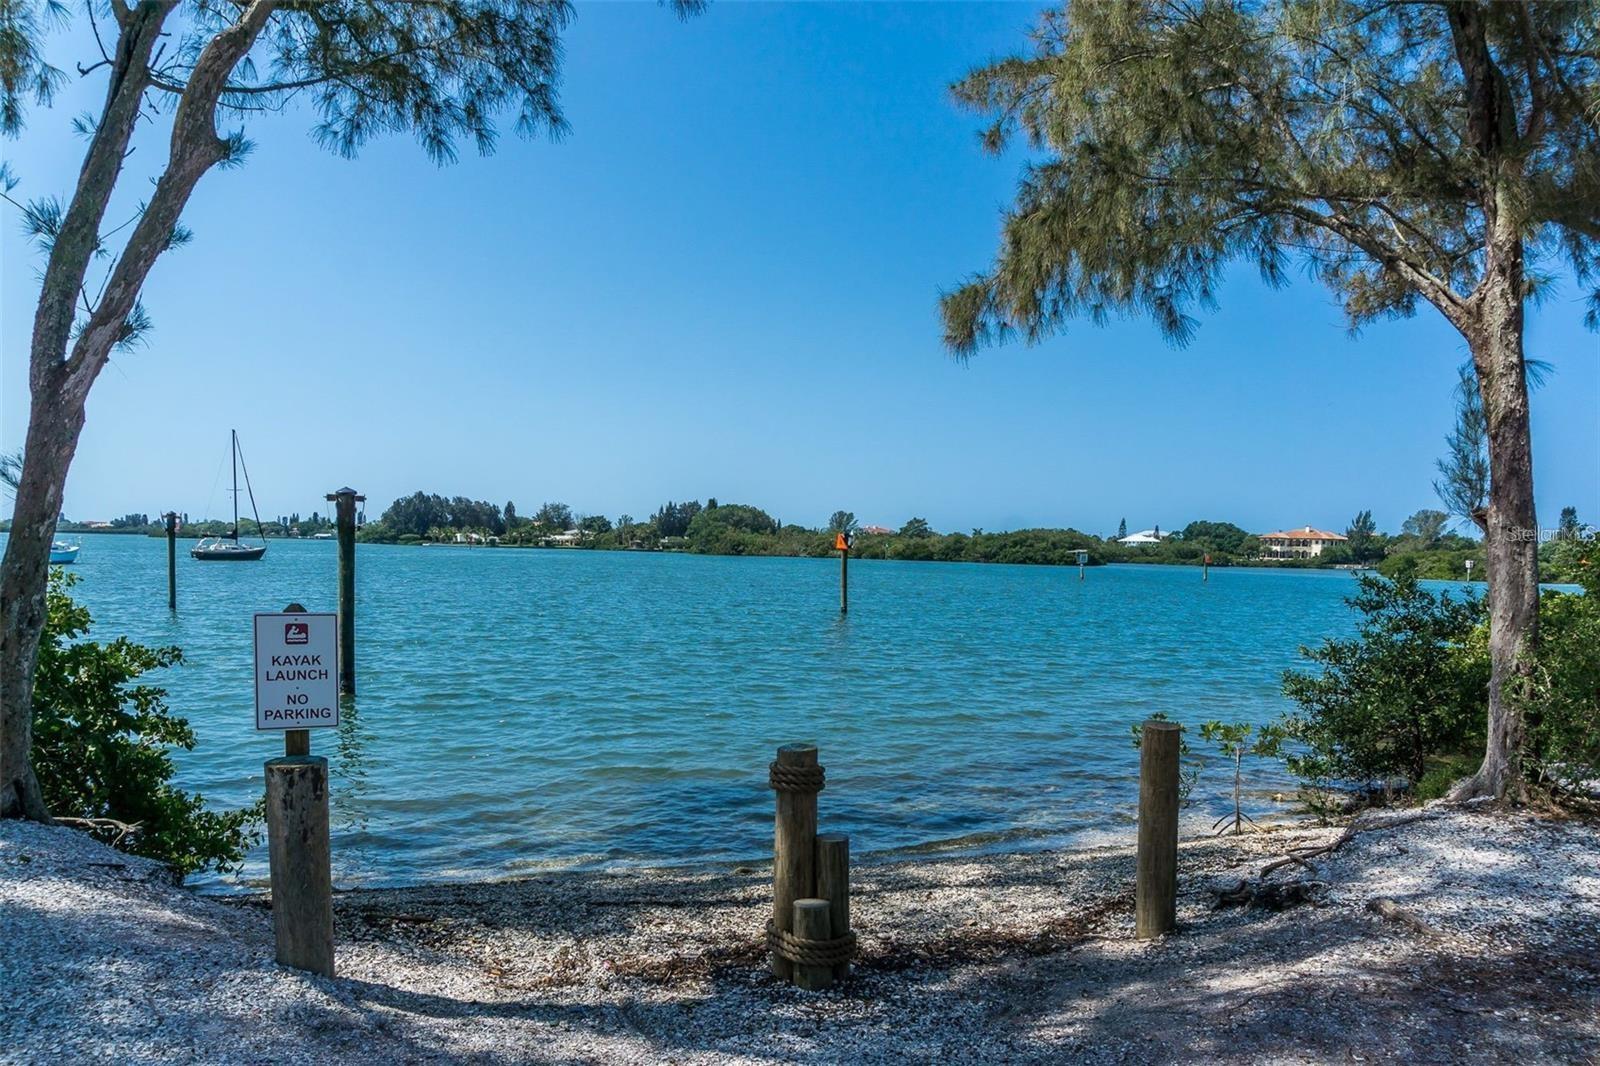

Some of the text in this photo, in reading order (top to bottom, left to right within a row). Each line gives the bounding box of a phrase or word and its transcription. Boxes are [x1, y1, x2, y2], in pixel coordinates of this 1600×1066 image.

[271, 655, 321, 666] KAYAK
[266, 669, 328, 681] LAUNCH
[287, 694, 309, 705] NO
[264, 707, 331, 720] PARKING
